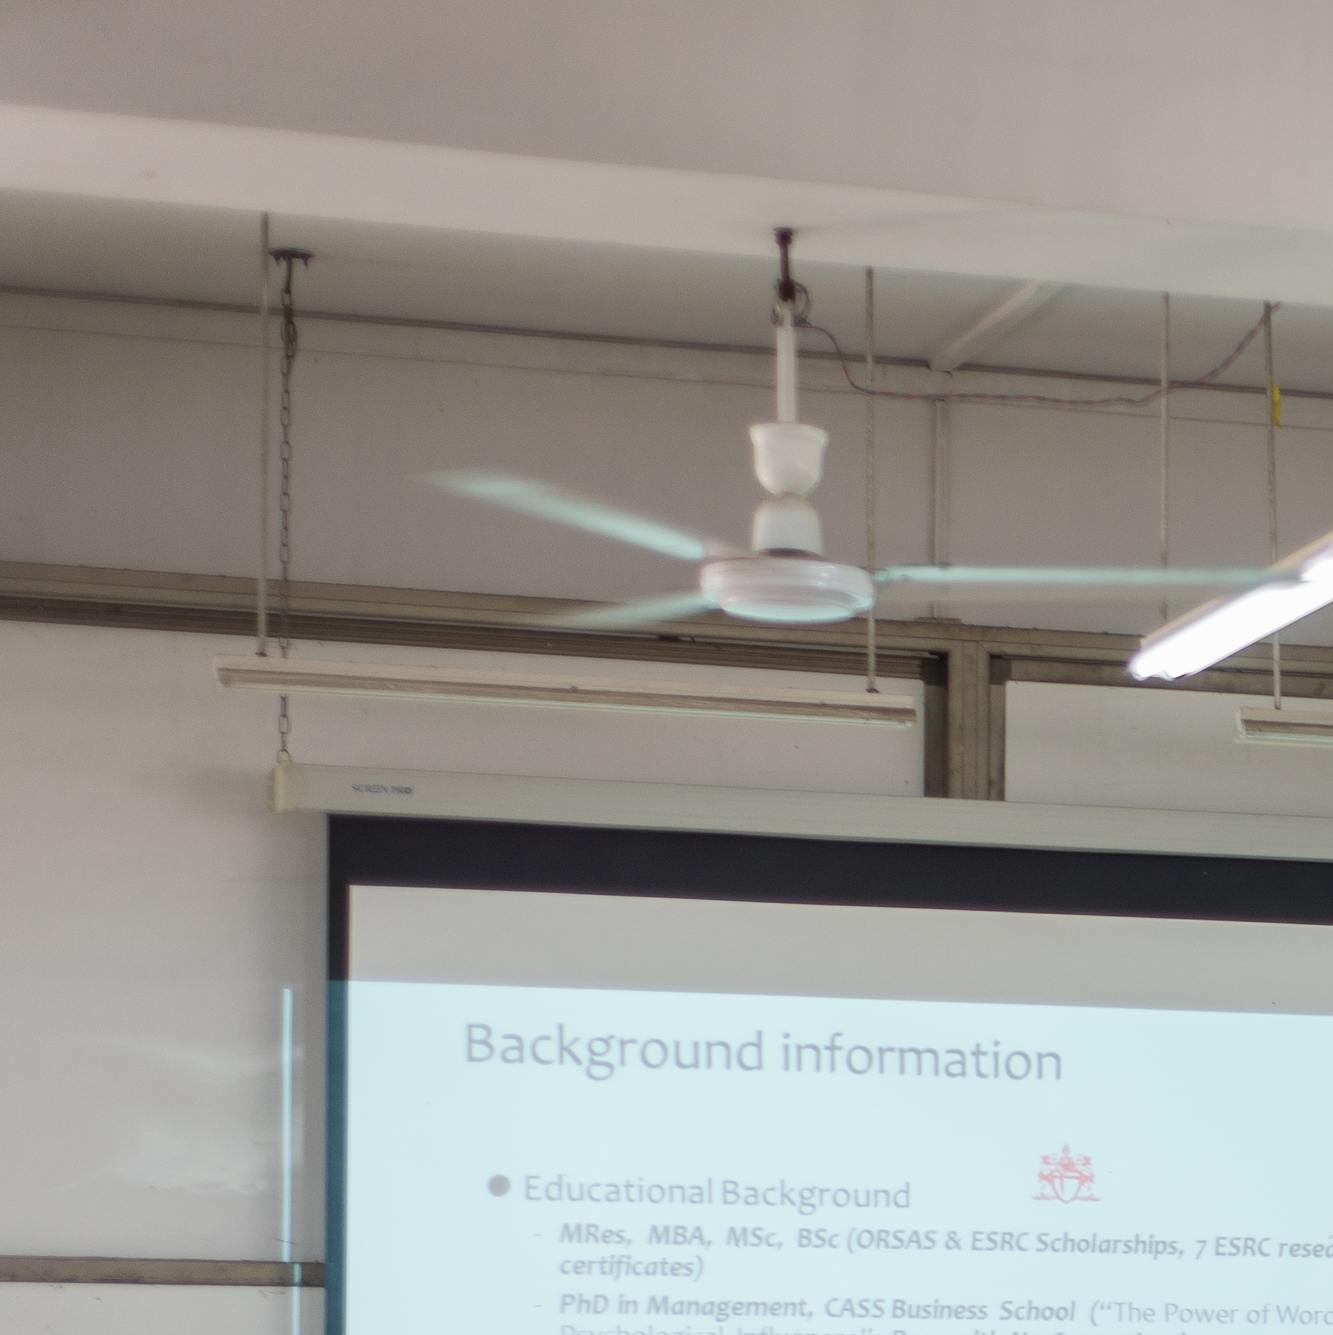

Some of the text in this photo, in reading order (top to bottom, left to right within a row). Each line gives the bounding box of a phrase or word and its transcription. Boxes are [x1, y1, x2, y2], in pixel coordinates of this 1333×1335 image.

[464, 1022, 1062, 1083] Background information
[523, 1173, 911, 1217] Educational Background
[558, 1222, 633, 1248] MRes,
[646, 1224, 713, 1250] MBA,
[724, 1225, 784, 1251] MSc,
[796, 1227, 840, 1250] BSc
[844, 1227, 938, 1255] (ORSAS
[942, 1229, 963, 1251] &
[969, 1230, 1030, 1253] ESRC
[1034, 1231, 1185, 1261] Scholarships,
[1194, 1238, 1209, 1261] 7
[1213, 1235, 1272, 1258] ESRC
[557, 1253, 705, 1283] certificates)
[558, 1292, 610, 1315] PhD
[616, 1293, 639, 1315] in
[645, 1294, 814, 1324] Management,
[823, 1297, 886, 1319] CASS
[890, 1298, 989, 1321] Business
[998, 1299, 1077, 1322] School
[1163, 1302, 1240, 1325] Power
[1244, 1303, 1271, 1325] of
